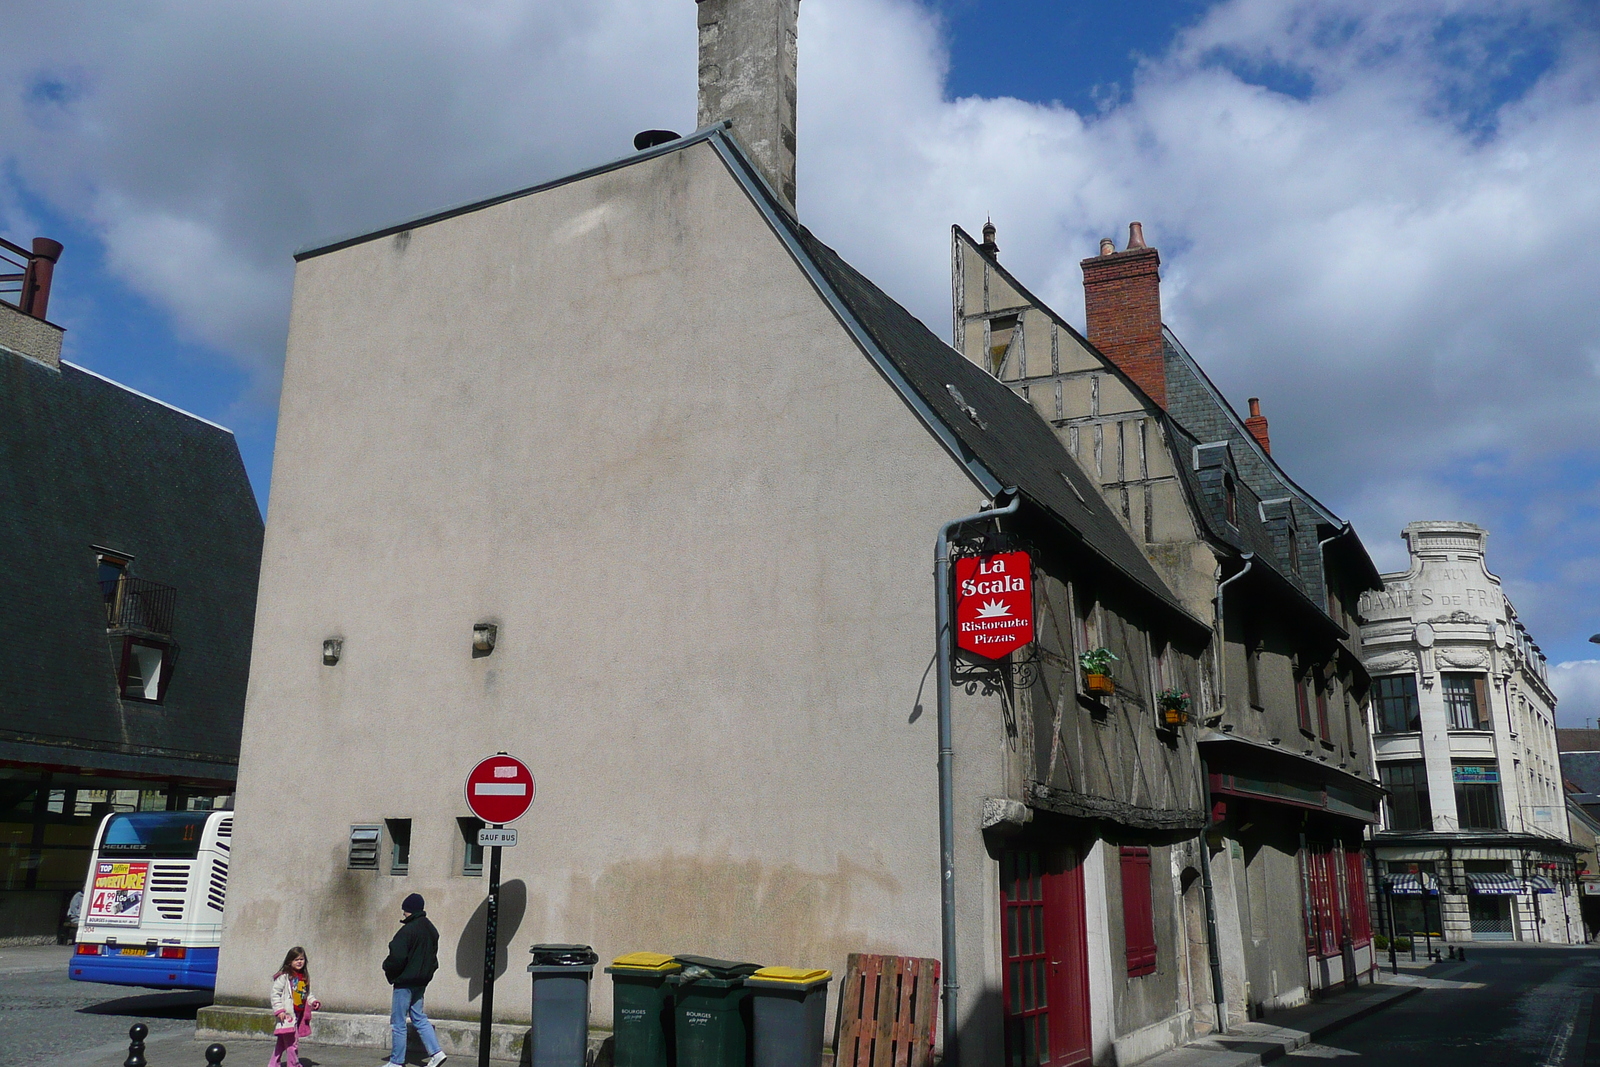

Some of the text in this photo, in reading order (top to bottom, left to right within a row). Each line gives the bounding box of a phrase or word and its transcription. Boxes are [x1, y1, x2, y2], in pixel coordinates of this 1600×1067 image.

[980, 558, 1005, 575] La
[1444, 568, 1468, 580] AUX
[961, 575, 1025, 597] Scala
[1360, 588, 1434, 612] DAMES
[1441, 595, 1462, 606] DE
[961, 618, 1028, 632] Ristorante
[974, 634, 1016, 645] Pizzas
[183, 824, 195, 840] 11
[100, 864, 113, 873] TOP
[96, 872, 146, 889] OUVERTURE
